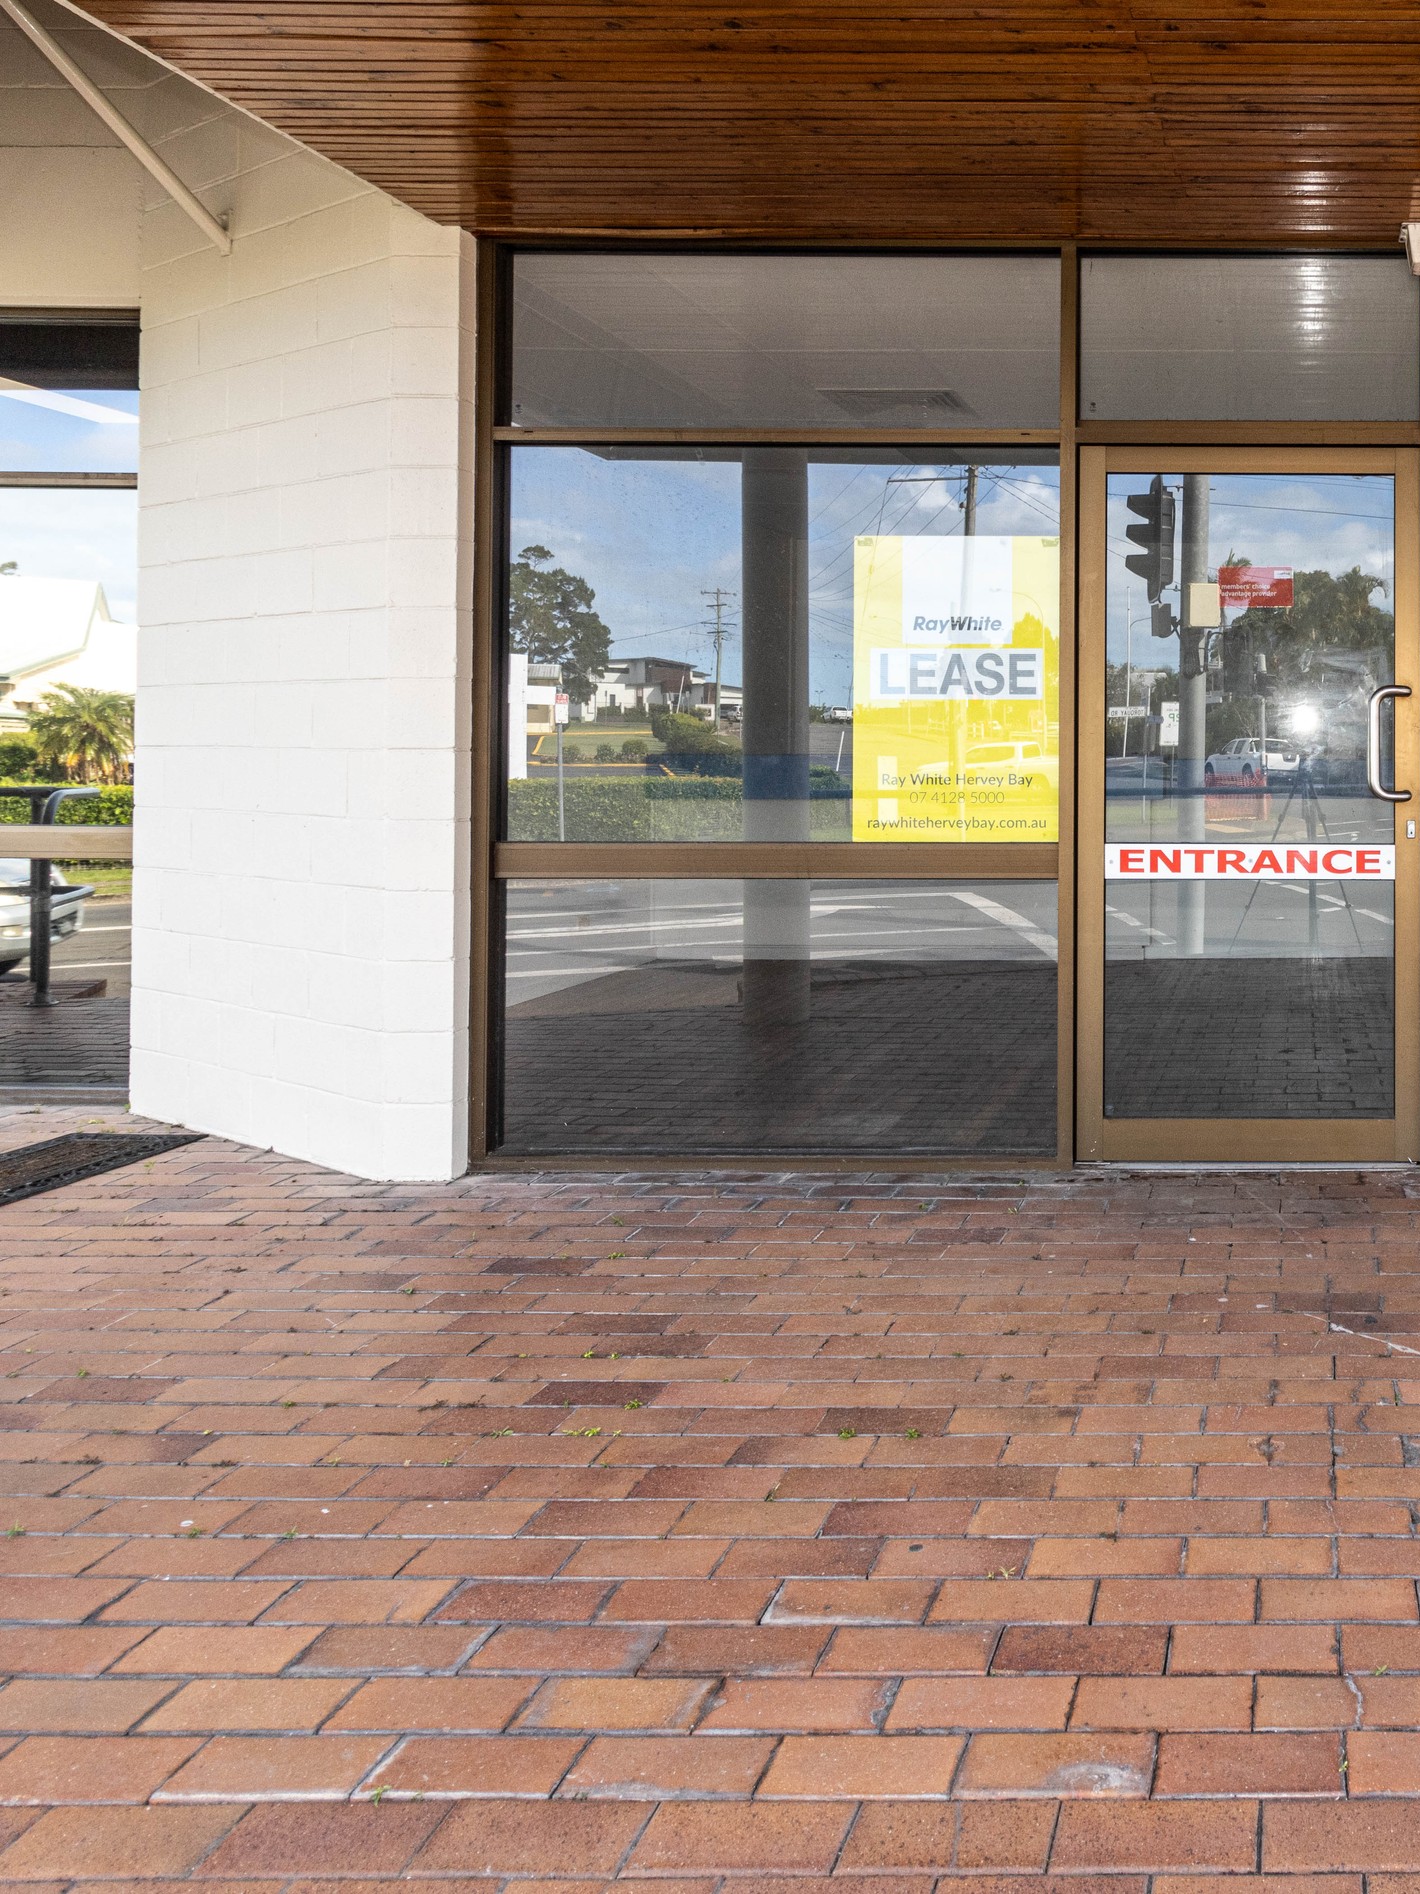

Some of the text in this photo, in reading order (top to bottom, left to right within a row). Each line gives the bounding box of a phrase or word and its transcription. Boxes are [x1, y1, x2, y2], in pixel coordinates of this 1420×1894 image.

[880, 653, 1037, 695] LEASE
[882, 773, 1033, 788] Ray White Hervey Bay
[909, 791, 1005, 804] 07 4128 5000
[867, 816, 1047, 831] raywhiteherveybay.com.au
[1119, 849, 1381, 874] ENTRANCE
